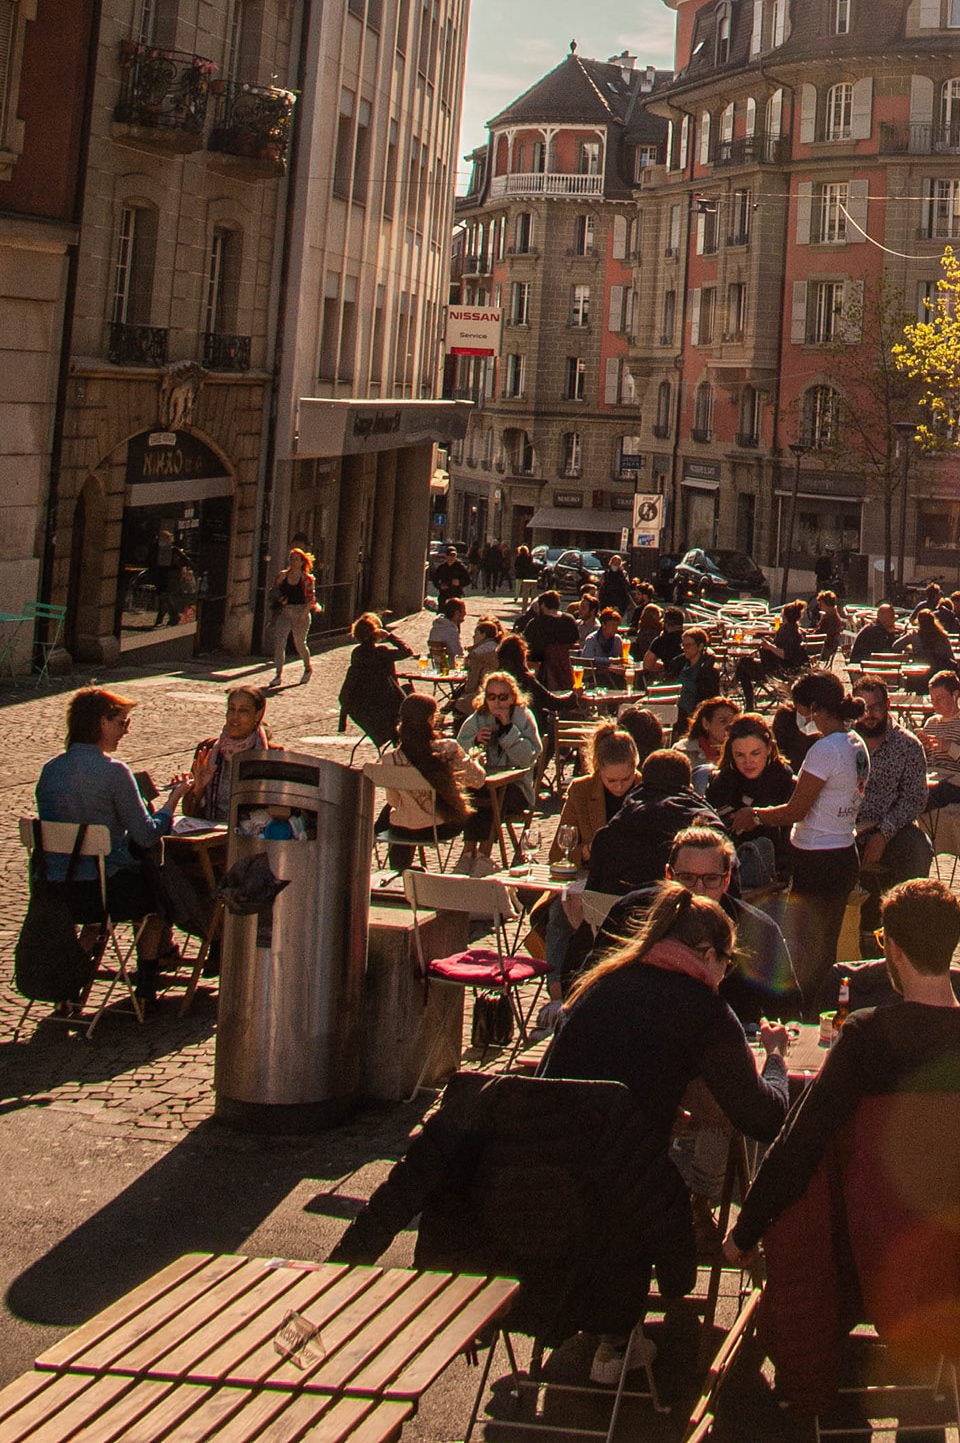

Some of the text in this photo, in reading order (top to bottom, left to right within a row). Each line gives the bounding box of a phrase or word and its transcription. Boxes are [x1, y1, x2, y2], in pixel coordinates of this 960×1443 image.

[450, 311, 500, 322] NISSAN
[459, 332, 488, 340] Service
[557, 495, 580, 503] MAURO
